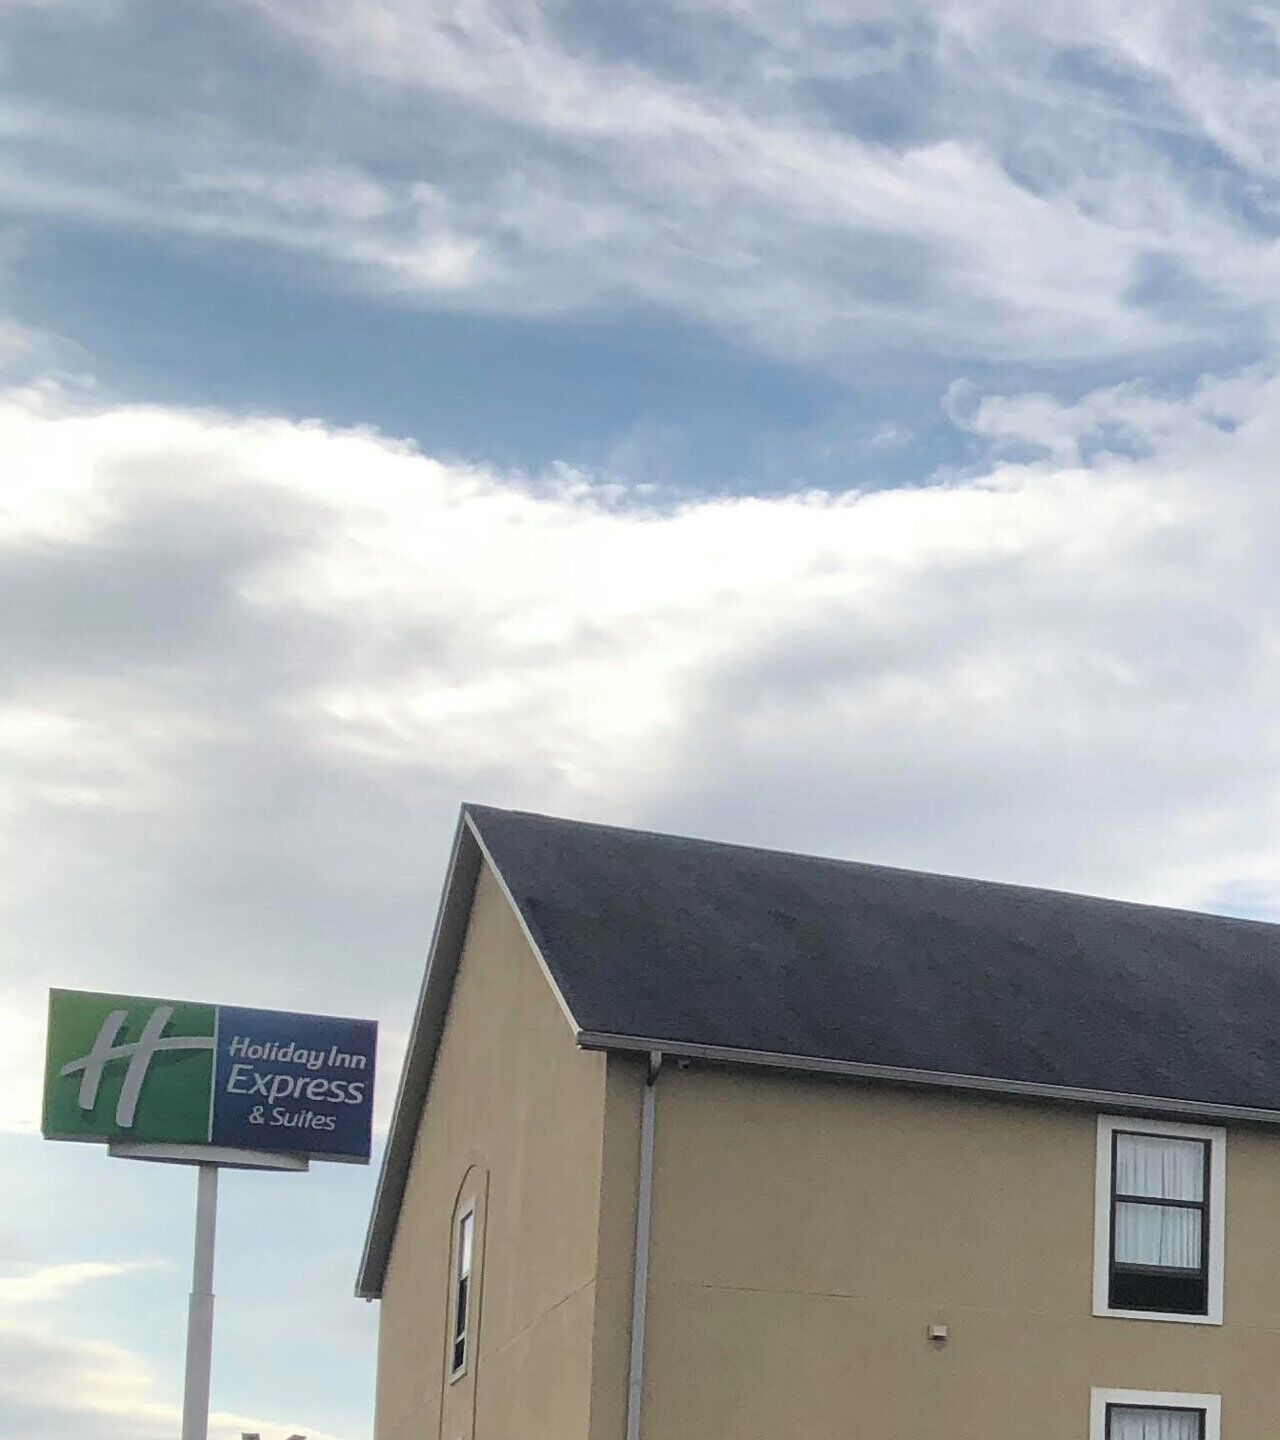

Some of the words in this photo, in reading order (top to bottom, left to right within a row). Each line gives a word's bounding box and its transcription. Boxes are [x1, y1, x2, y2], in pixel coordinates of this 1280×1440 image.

[228, 1034, 325, 1070] Holiday
[327, 1046, 367, 1070] Inn
[226, 1063, 366, 1105] Express
[248, 1106, 265, 1125] &
[269, 1106, 337, 1131] Suites
